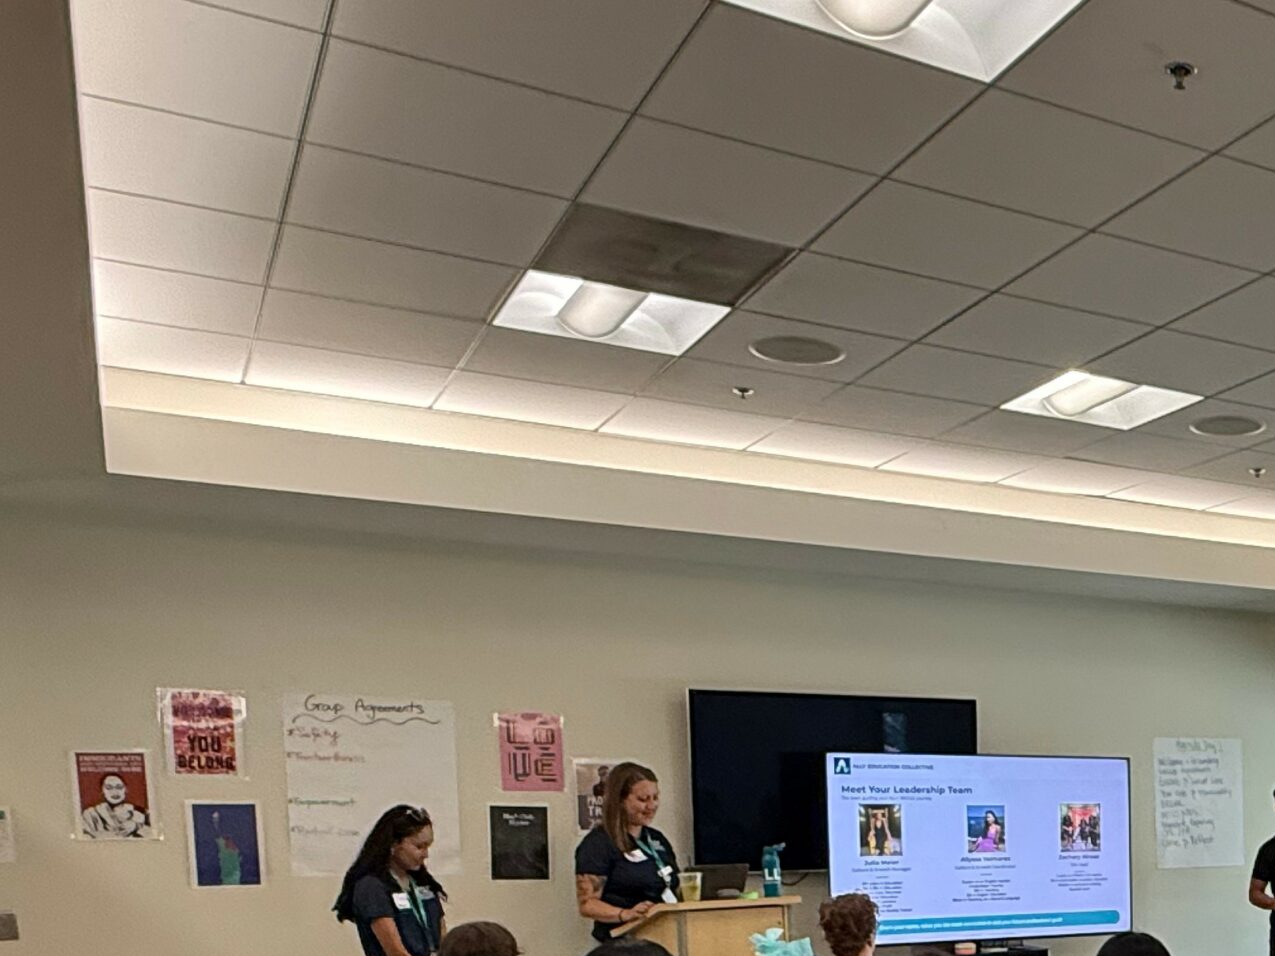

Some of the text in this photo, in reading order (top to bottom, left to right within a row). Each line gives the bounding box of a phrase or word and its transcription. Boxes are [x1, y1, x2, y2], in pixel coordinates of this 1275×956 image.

[304, 694, 425, 720] Group Agreements
[187, 735, 222, 754] YOU
[177, 754, 237, 772] BELONG
[841, 785, 973, 796] Meet Your Leadership Team
